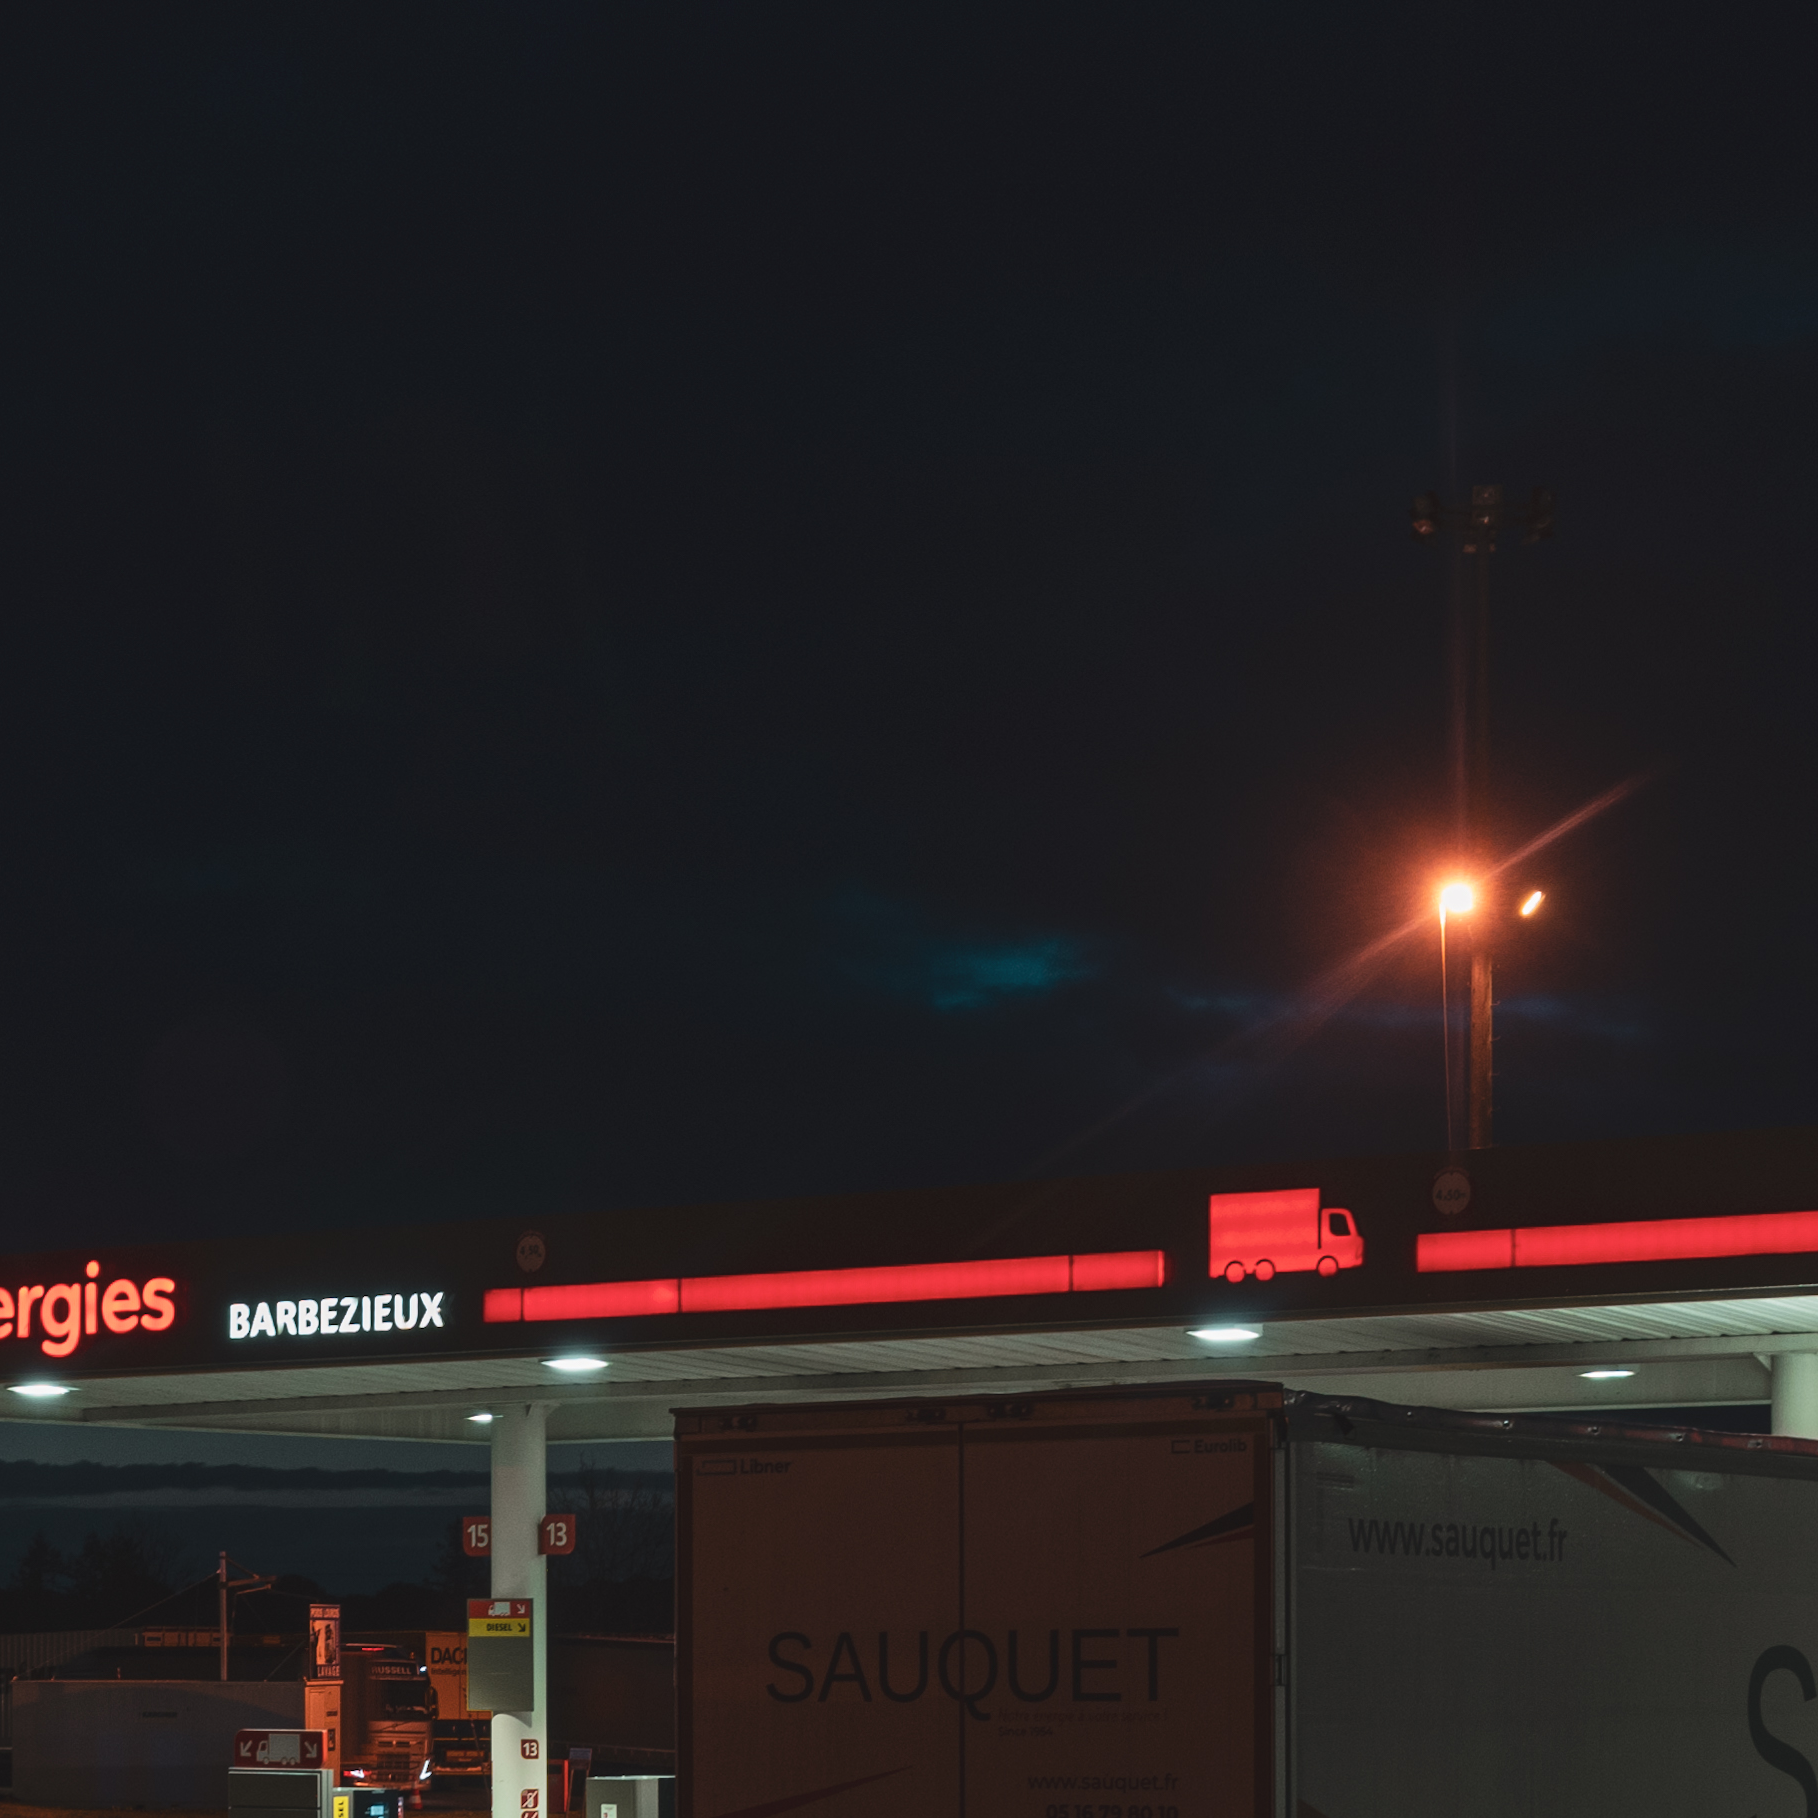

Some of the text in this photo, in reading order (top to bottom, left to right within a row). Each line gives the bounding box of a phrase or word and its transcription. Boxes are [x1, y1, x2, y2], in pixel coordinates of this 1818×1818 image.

[227, 1291, 445, 1340] BARBEZIEUX
[1194, 1438, 1248, 1454] Eurolib
[739, 1458, 793, 1475] Libner
[467, 1523, 489, 1548] 15
[546, 1522, 568, 1547] 13
[1347, 1516, 1569, 1571] www.sauquet.fr
[486, 1623, 513, 1632] DIESEL
[764, 1626, 1181, 1721] SAUQUET
[998, 1725, 1028, 1737] Since
[523, 1742, 538, 1757] 13
[1027, 1772, 1180, 1794] www.sauquet.fr
